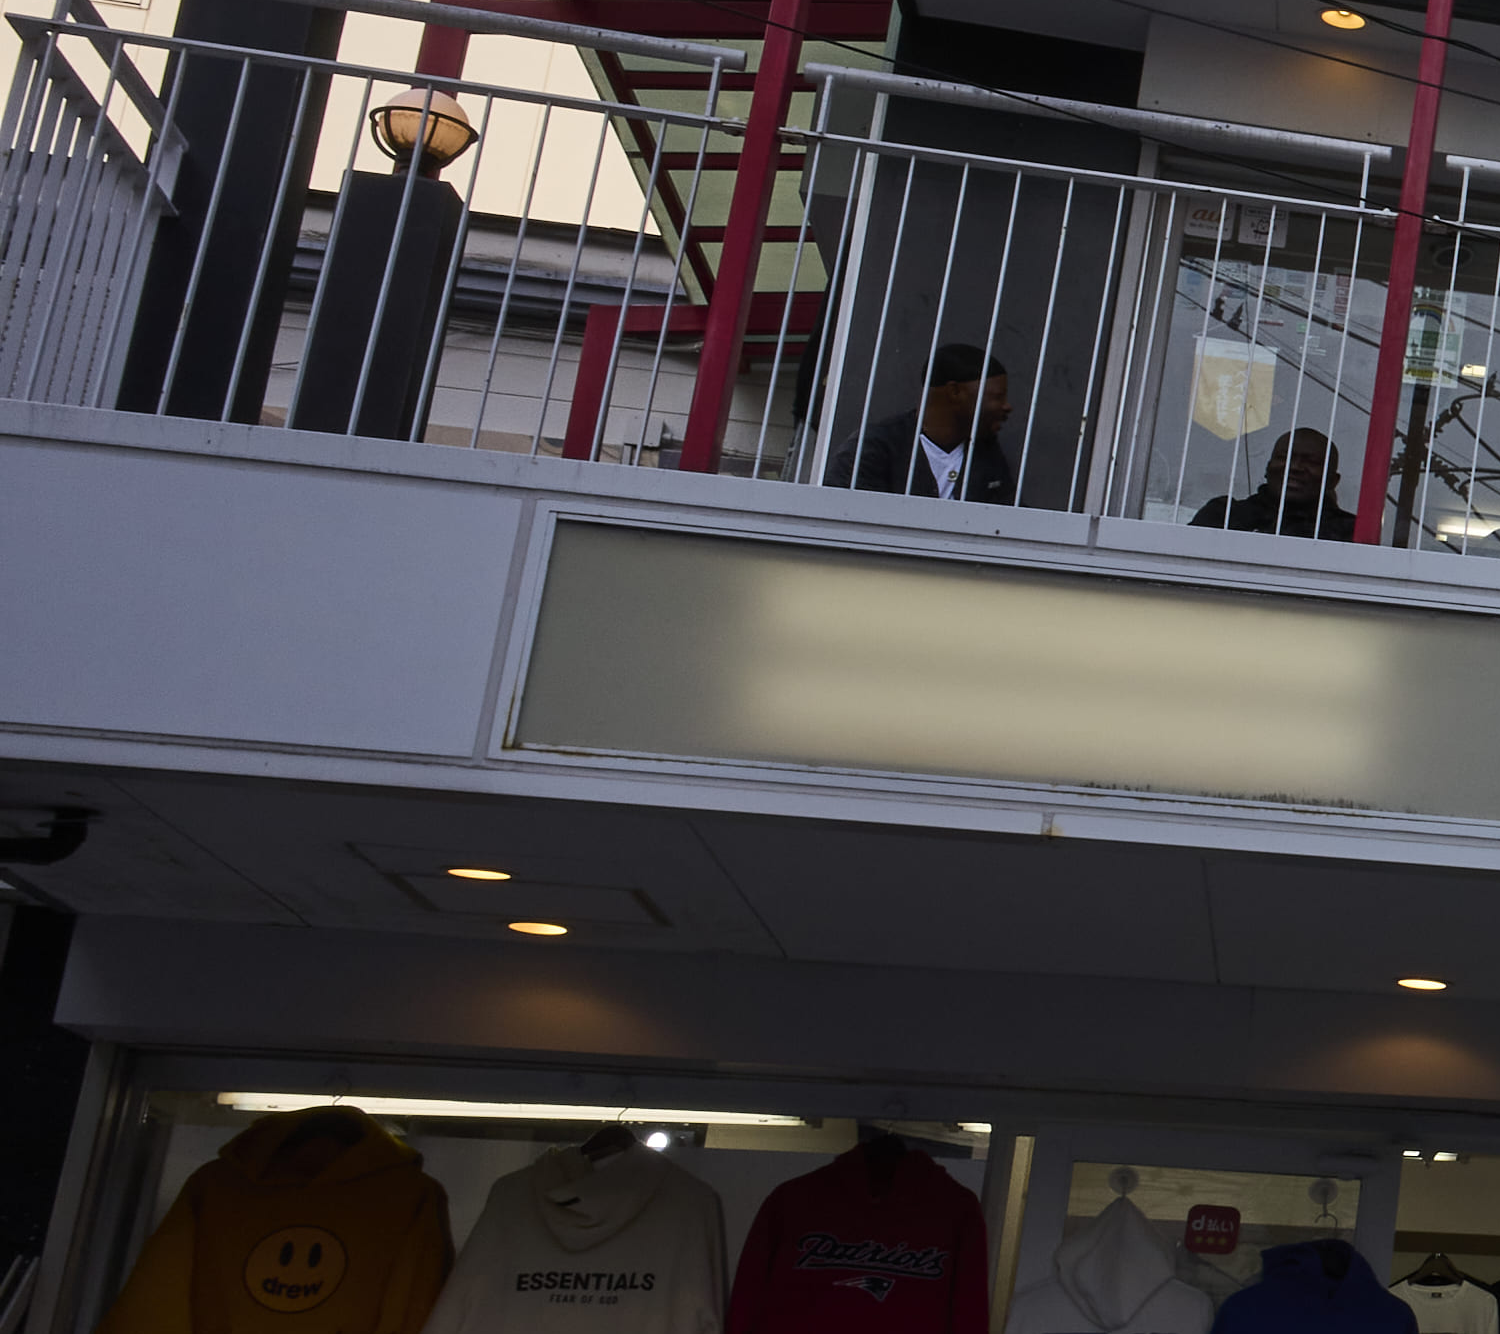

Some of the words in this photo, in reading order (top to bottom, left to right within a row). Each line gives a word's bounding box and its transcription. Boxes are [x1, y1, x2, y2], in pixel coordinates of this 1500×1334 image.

[796, 1232, 949, 1276] Patriots
[262, 1276, 324, 1299] drew
[516, 1271, 656, 1292] ESSENTIALS
[549, 1293, 576, 1304] FEAR
[580, 1294, 593, 1304] OF
[599, 1295, 619, 1305] GOD
